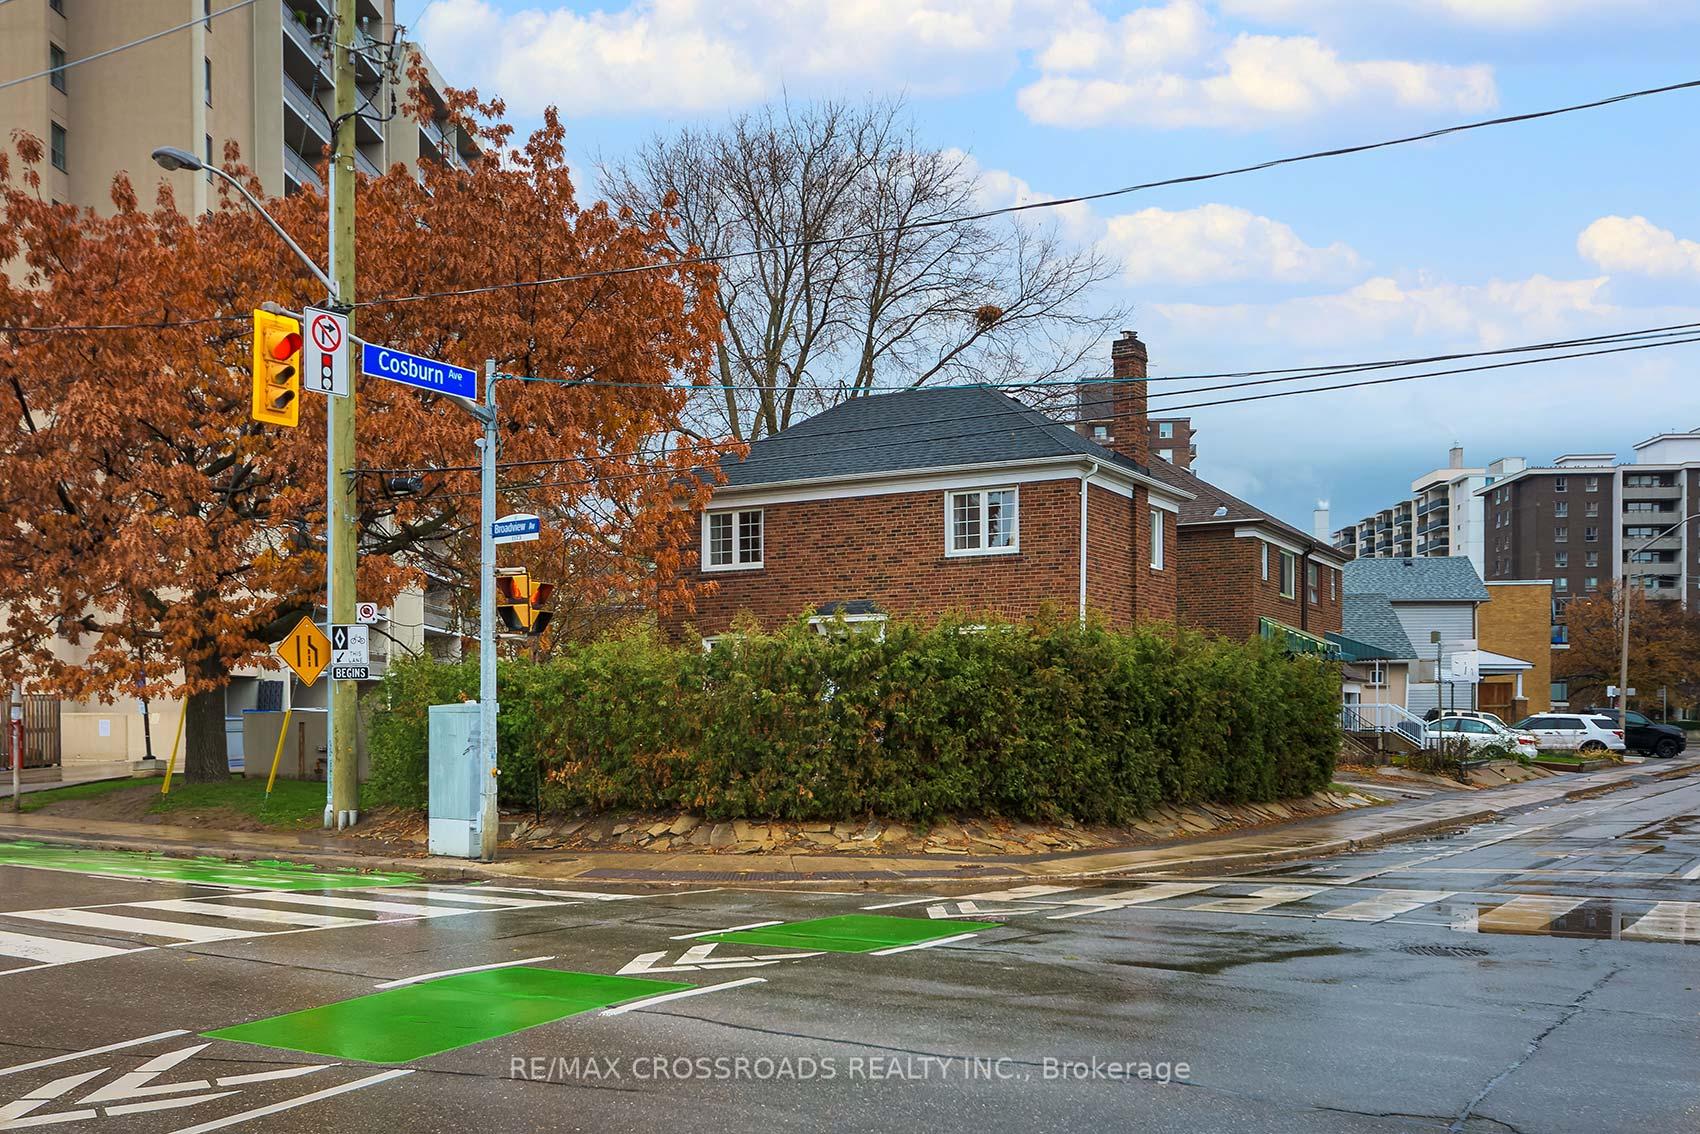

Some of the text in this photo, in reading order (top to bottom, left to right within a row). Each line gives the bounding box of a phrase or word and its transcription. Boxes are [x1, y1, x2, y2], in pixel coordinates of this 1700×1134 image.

[378, 350, 463, 385] Cosburn Ave
[494, 522, 526, 534] Broadview
[335, 668, 366, 678] BEGINS
